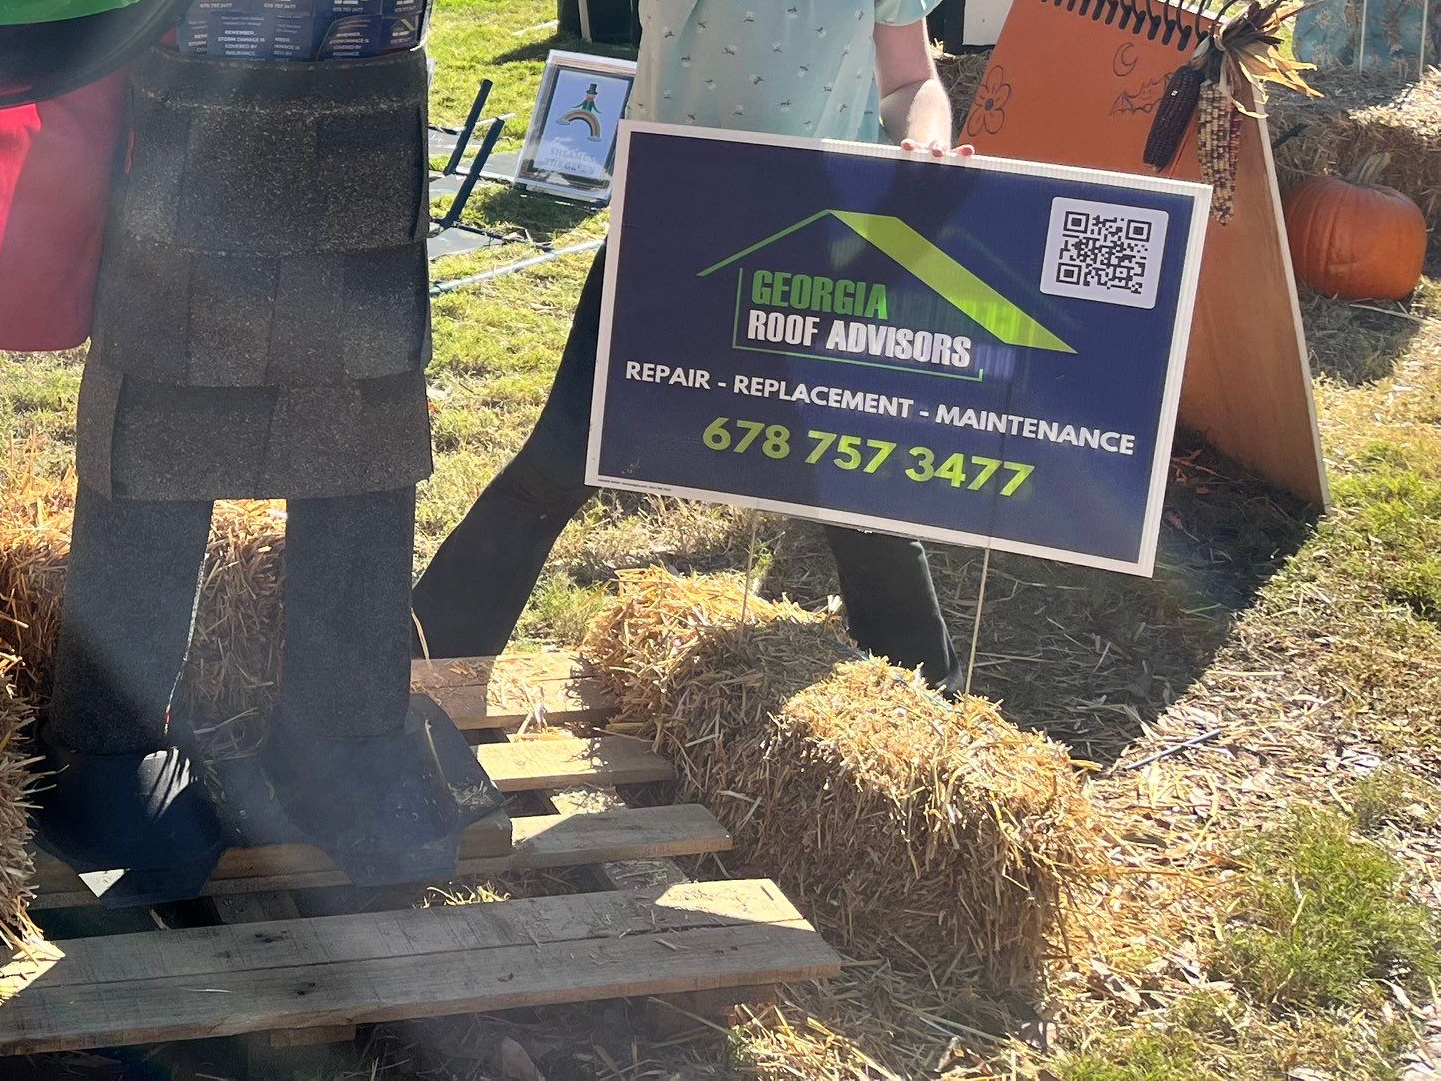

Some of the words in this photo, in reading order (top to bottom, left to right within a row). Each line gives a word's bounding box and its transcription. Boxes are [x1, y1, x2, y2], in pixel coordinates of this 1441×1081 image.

[751, 270, 889, 320] GEORGIA
[747, 310, 820, 346] ROOF
[826, 319, 973, 368] ADVISORS
[625, 361, 711, 390] REPAIR
[733, 375, 915, 419] REPLACEMENT
[935, 404, 1136, 456] MAINTENANCE
[701, 416, 792, 459] 678
[805, 430, 897, 474] 757
[904, 446, 1036, 498] 3477
